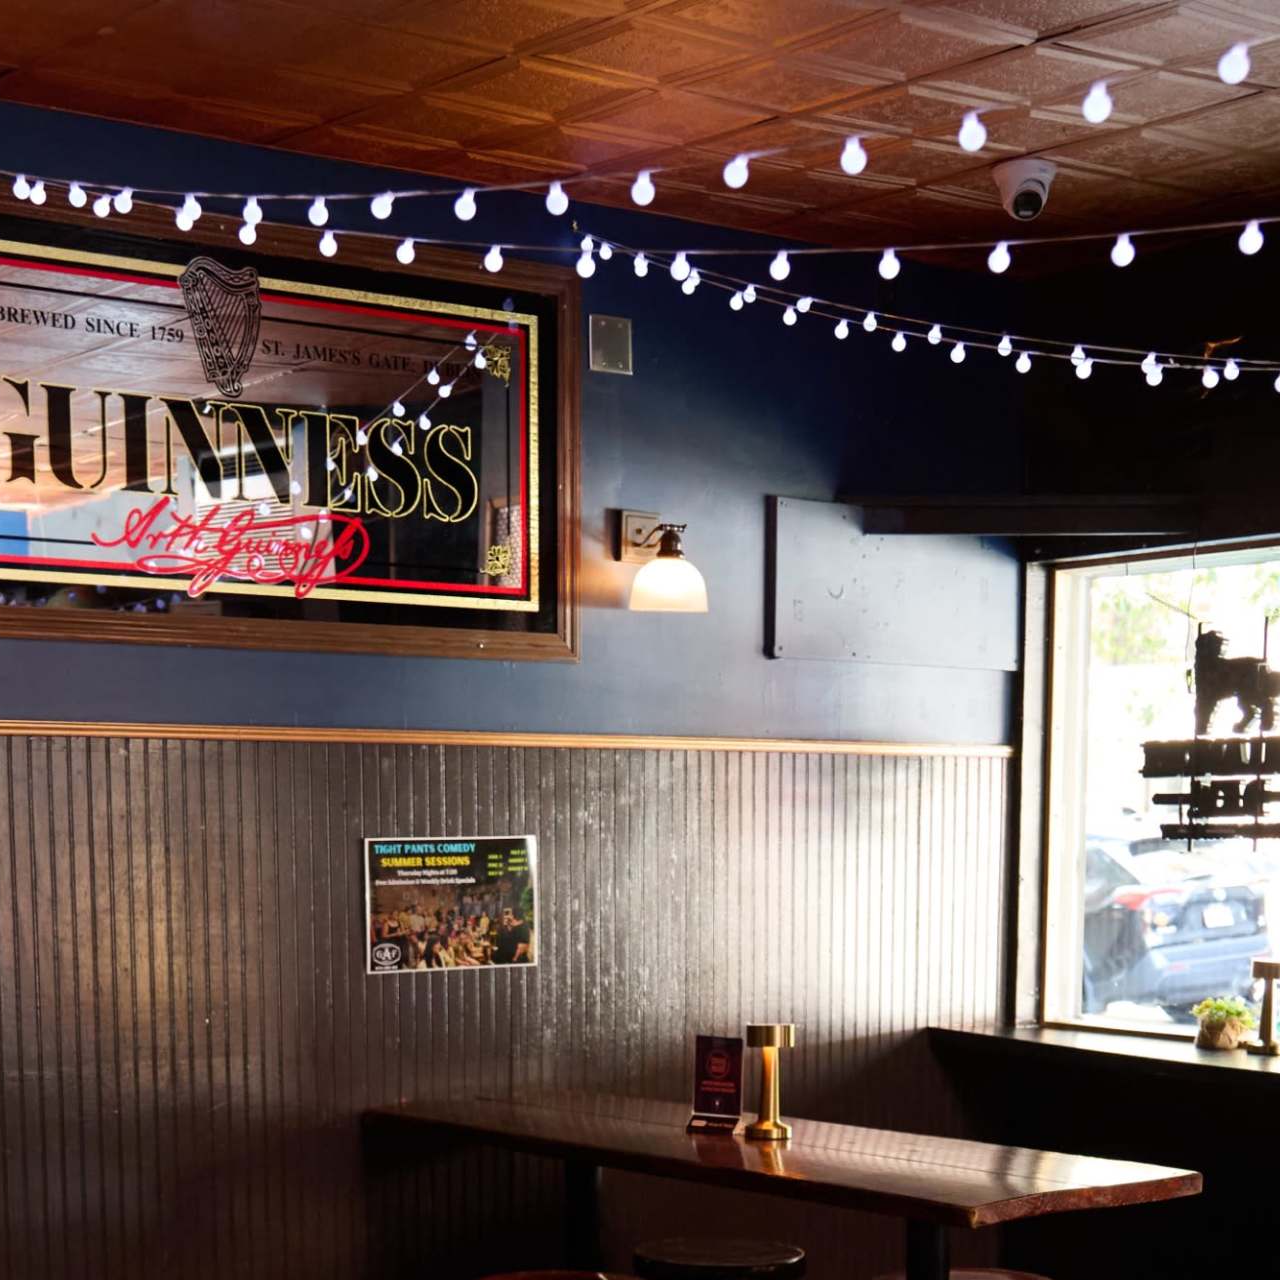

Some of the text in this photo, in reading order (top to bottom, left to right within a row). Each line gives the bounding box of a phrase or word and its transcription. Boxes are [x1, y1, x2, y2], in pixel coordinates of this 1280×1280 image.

[85, 316, 140, 339] SINCE
[151, 325, 185, 343] 1759
[261, 338, 285, 356] ST.
[293, 343, 362, 366] JAMES'S
[374, 843, 476, 854] TIGHT PANTS COMEDY
[381, 856, 471, 868] SUMMER SESSIONS
